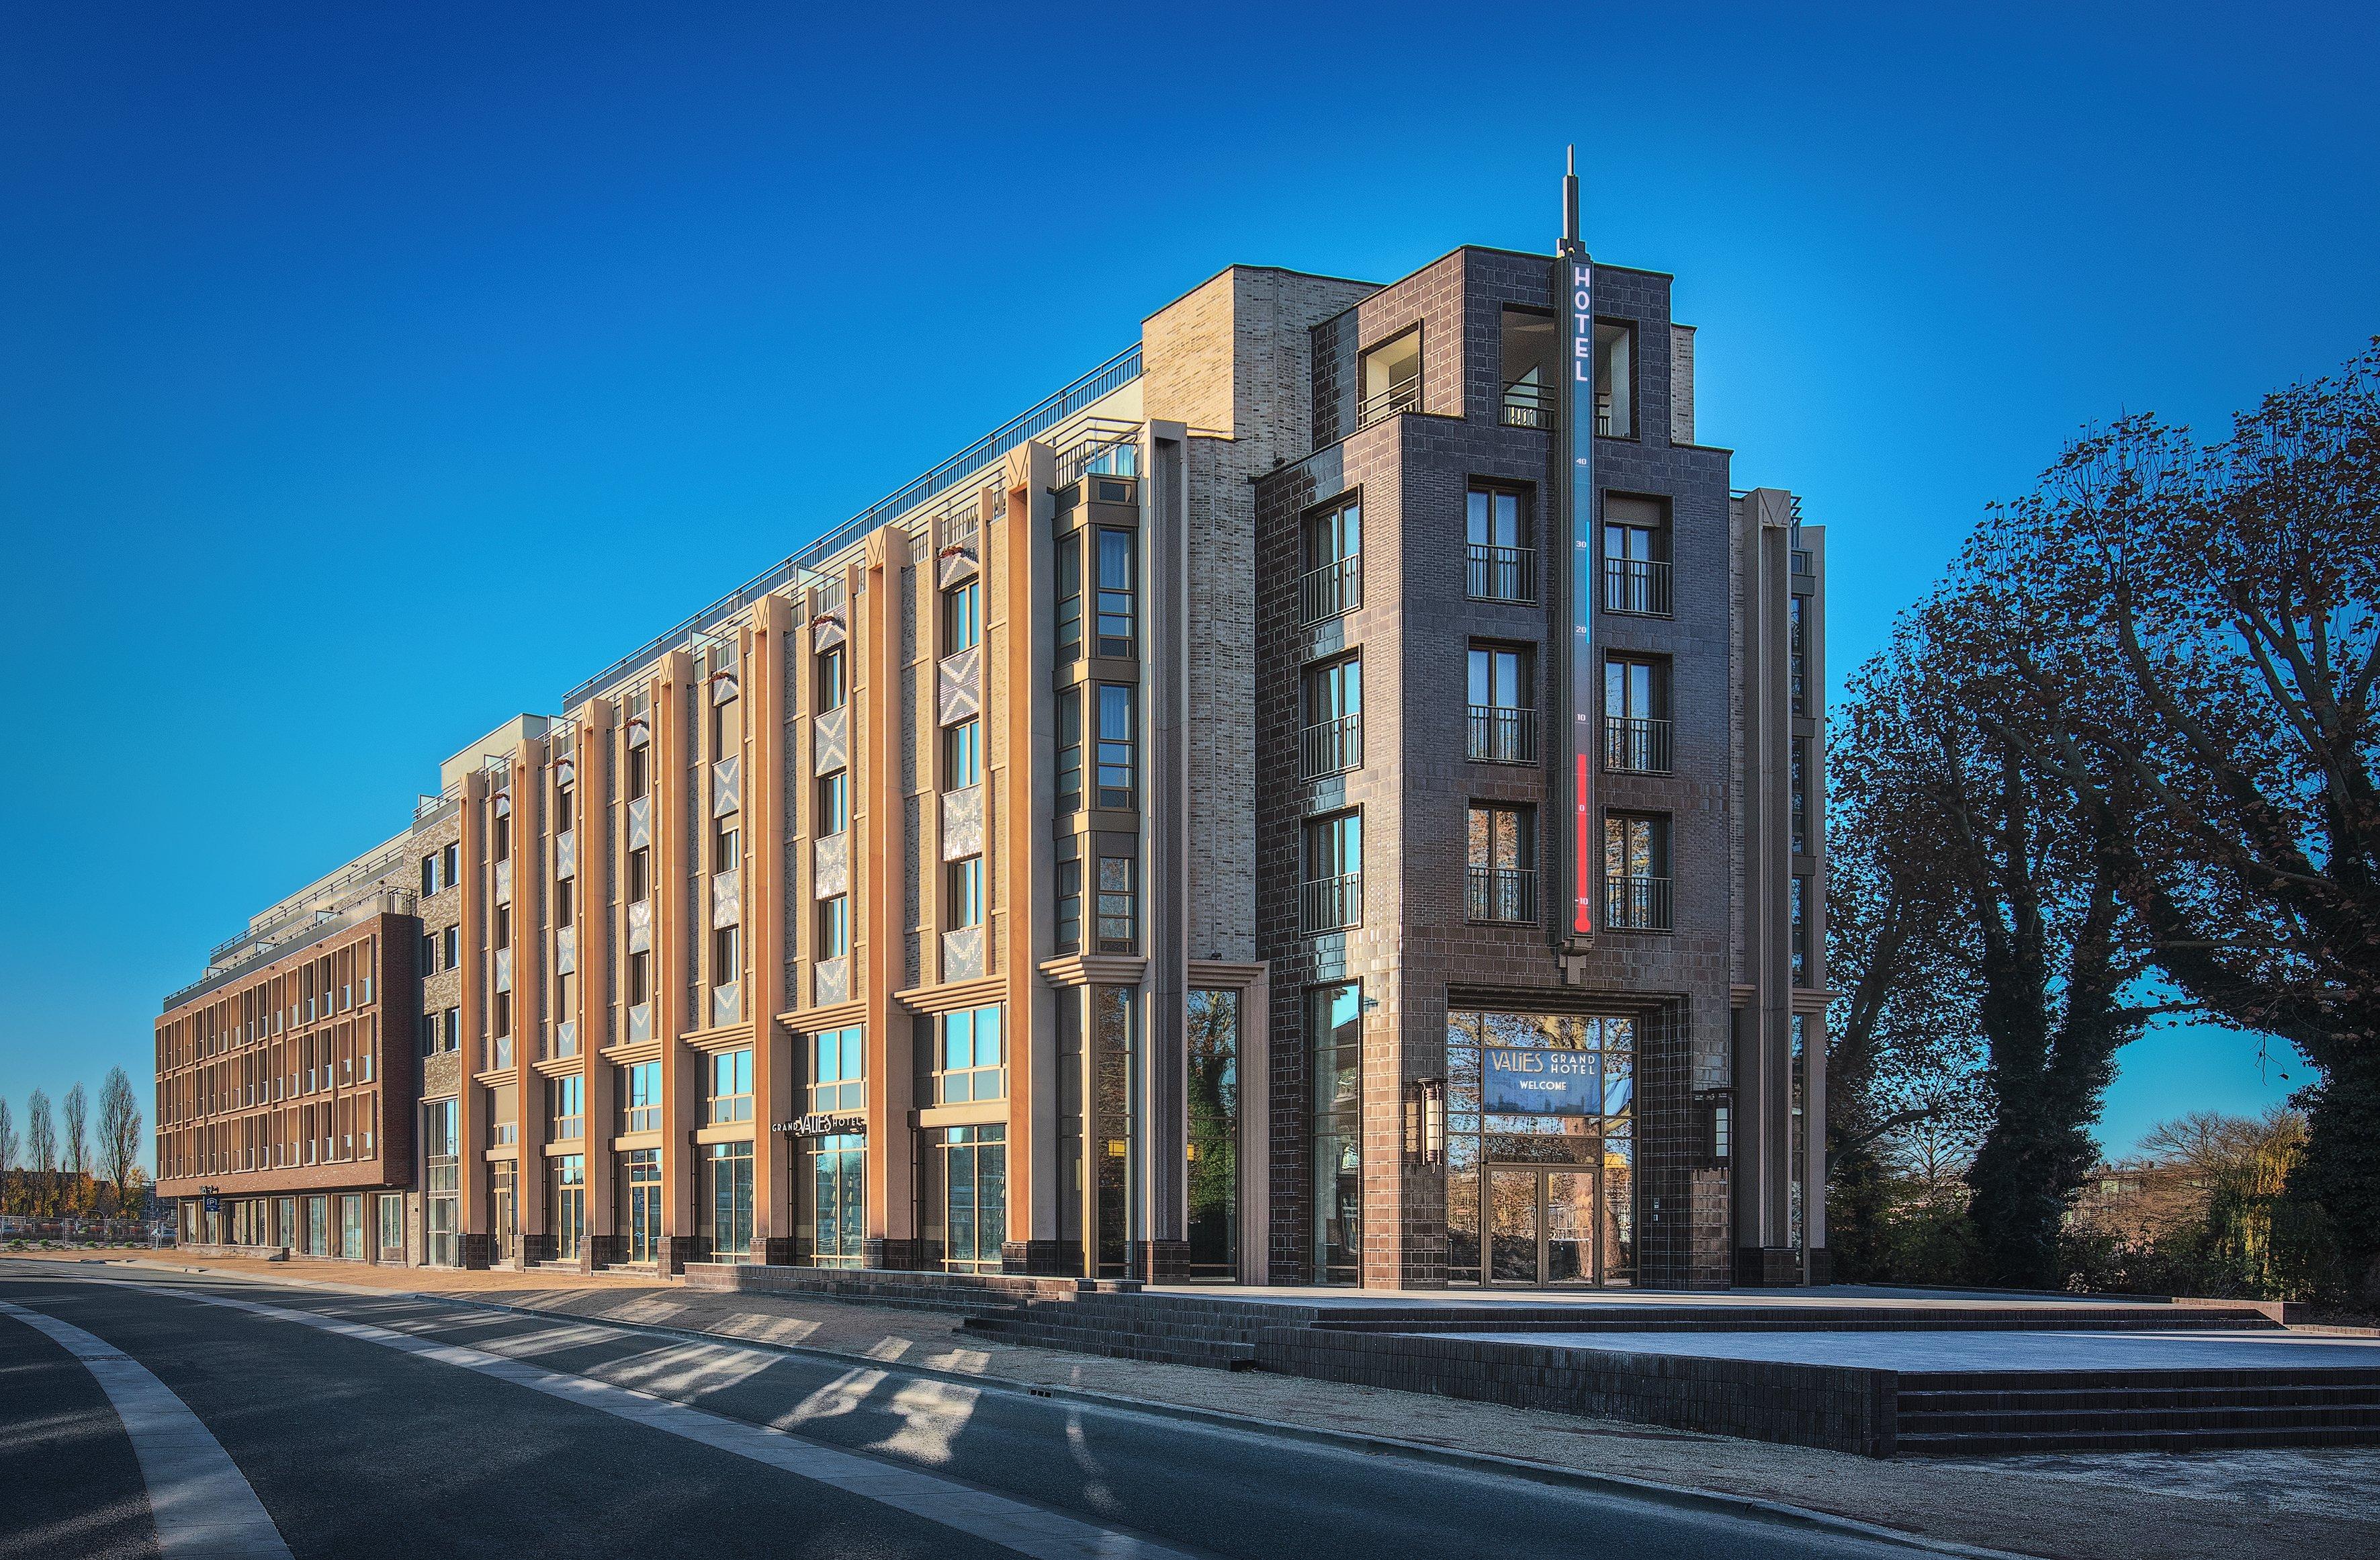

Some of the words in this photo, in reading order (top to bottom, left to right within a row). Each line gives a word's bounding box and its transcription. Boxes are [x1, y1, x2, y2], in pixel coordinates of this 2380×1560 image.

[1574, 267, 1590, 382] HOTEL
[1576, 540, 1587, 548] 30
[1575, 625, 1587, 634] 20
[1577, 713, 1586, 722] 10
[1574, 897, 1589, 905] -10
[1550, 1053, 1595, 1064] GRAND
[1551, 1064, 1595, 1075] HOTEL
[1519, 1080, 1567, 1091] WELCOME
[772, 1122, 798, 1132] GRAND
[833, 1117, 862, 1127] HOTEL
